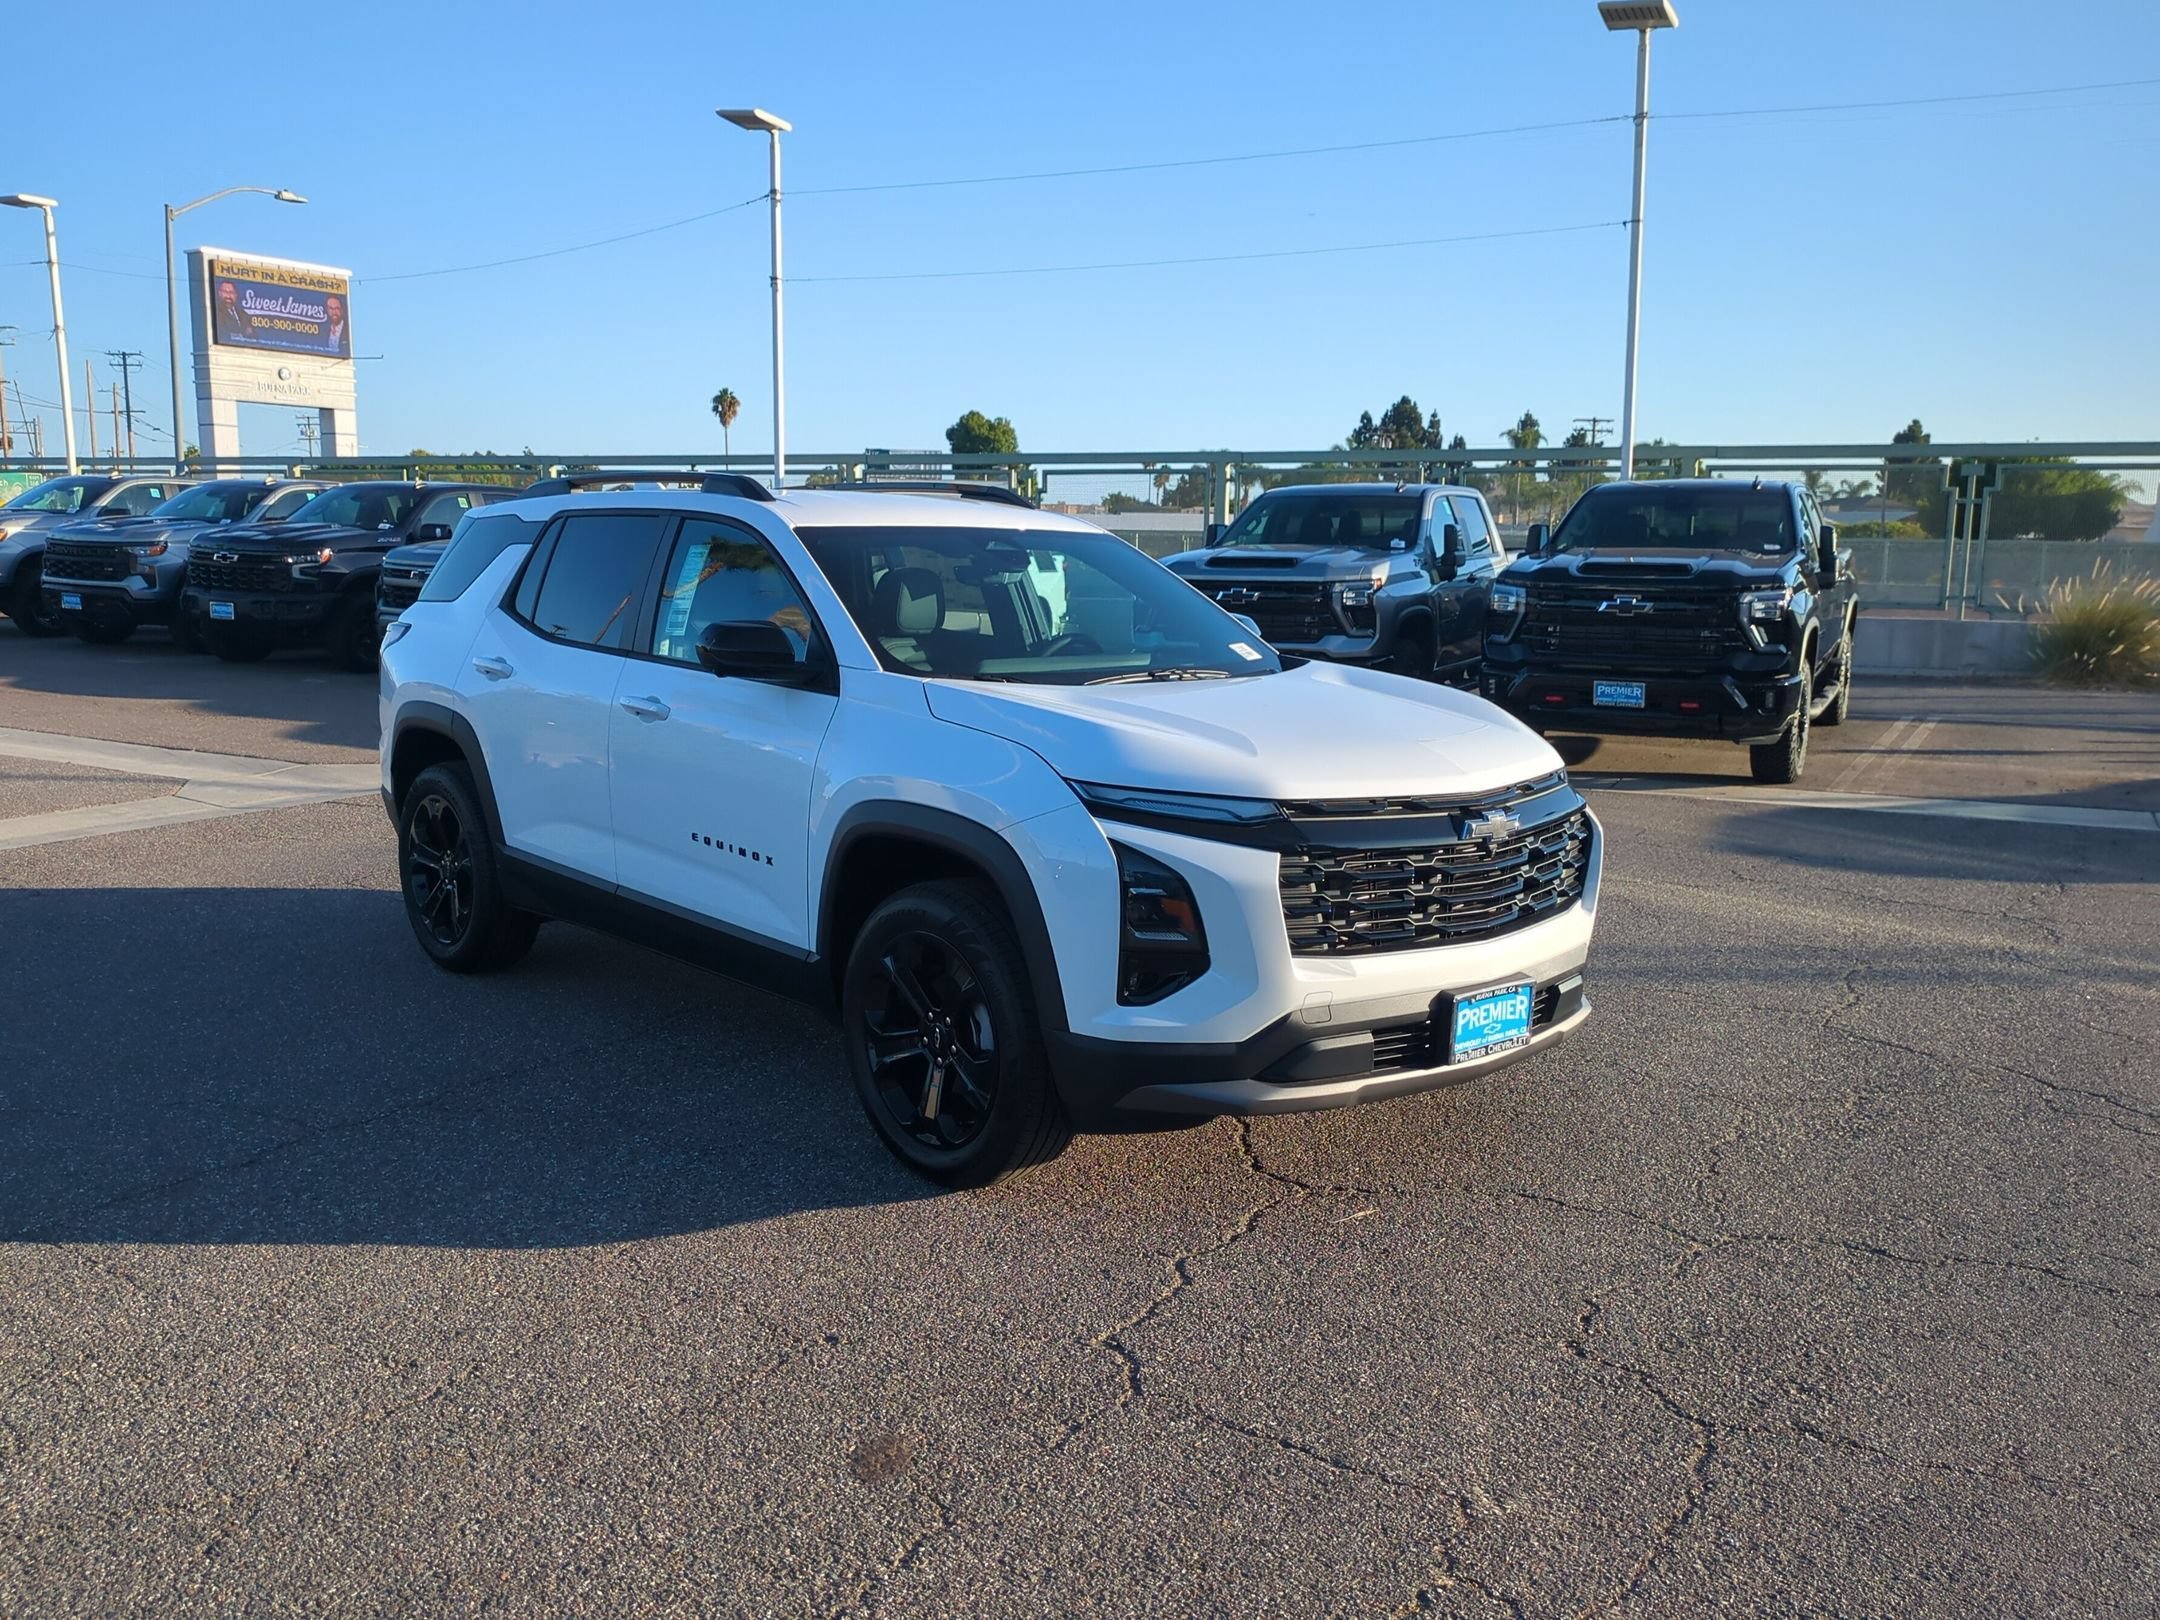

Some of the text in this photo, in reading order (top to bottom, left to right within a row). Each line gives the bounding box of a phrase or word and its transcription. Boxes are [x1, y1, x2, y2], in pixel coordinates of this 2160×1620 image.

[220, 265, 342, 291] HURT IN A CRASH?
[242, 289, 324, 318] Sweet James
[251, 316, 319, 334] 800-900-0000
[1597, 685, 1642, 697] PREMIER
[691, 832, 774, 866] EQUINOX
[1457, 994, 1529, 1036] PREMIER
[1455, 1037, 1528, 1064] PREMIER CHEVROLET
